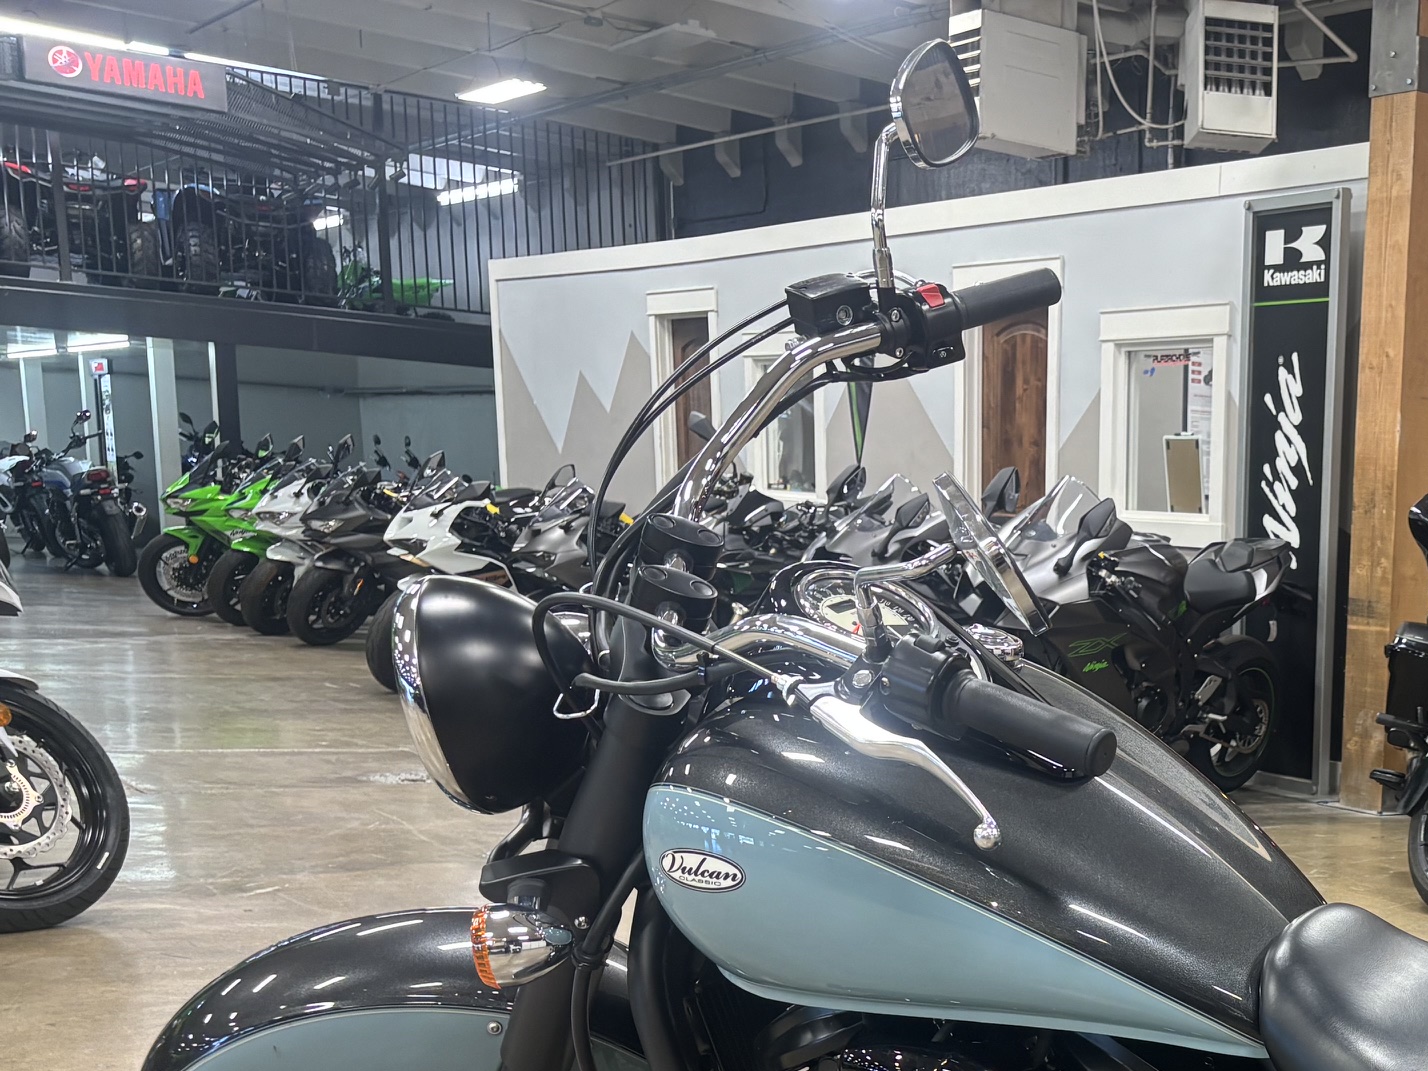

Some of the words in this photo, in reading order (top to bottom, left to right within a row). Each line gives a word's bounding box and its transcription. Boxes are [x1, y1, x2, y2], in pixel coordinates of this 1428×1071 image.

[84, 51, 205, 99] YAMAHA
[1263, 263, 1326, 287] Kawasaki
[665, 853, 740, 882] Vulcan
[678, 876, 722, 886] CLASSIC
